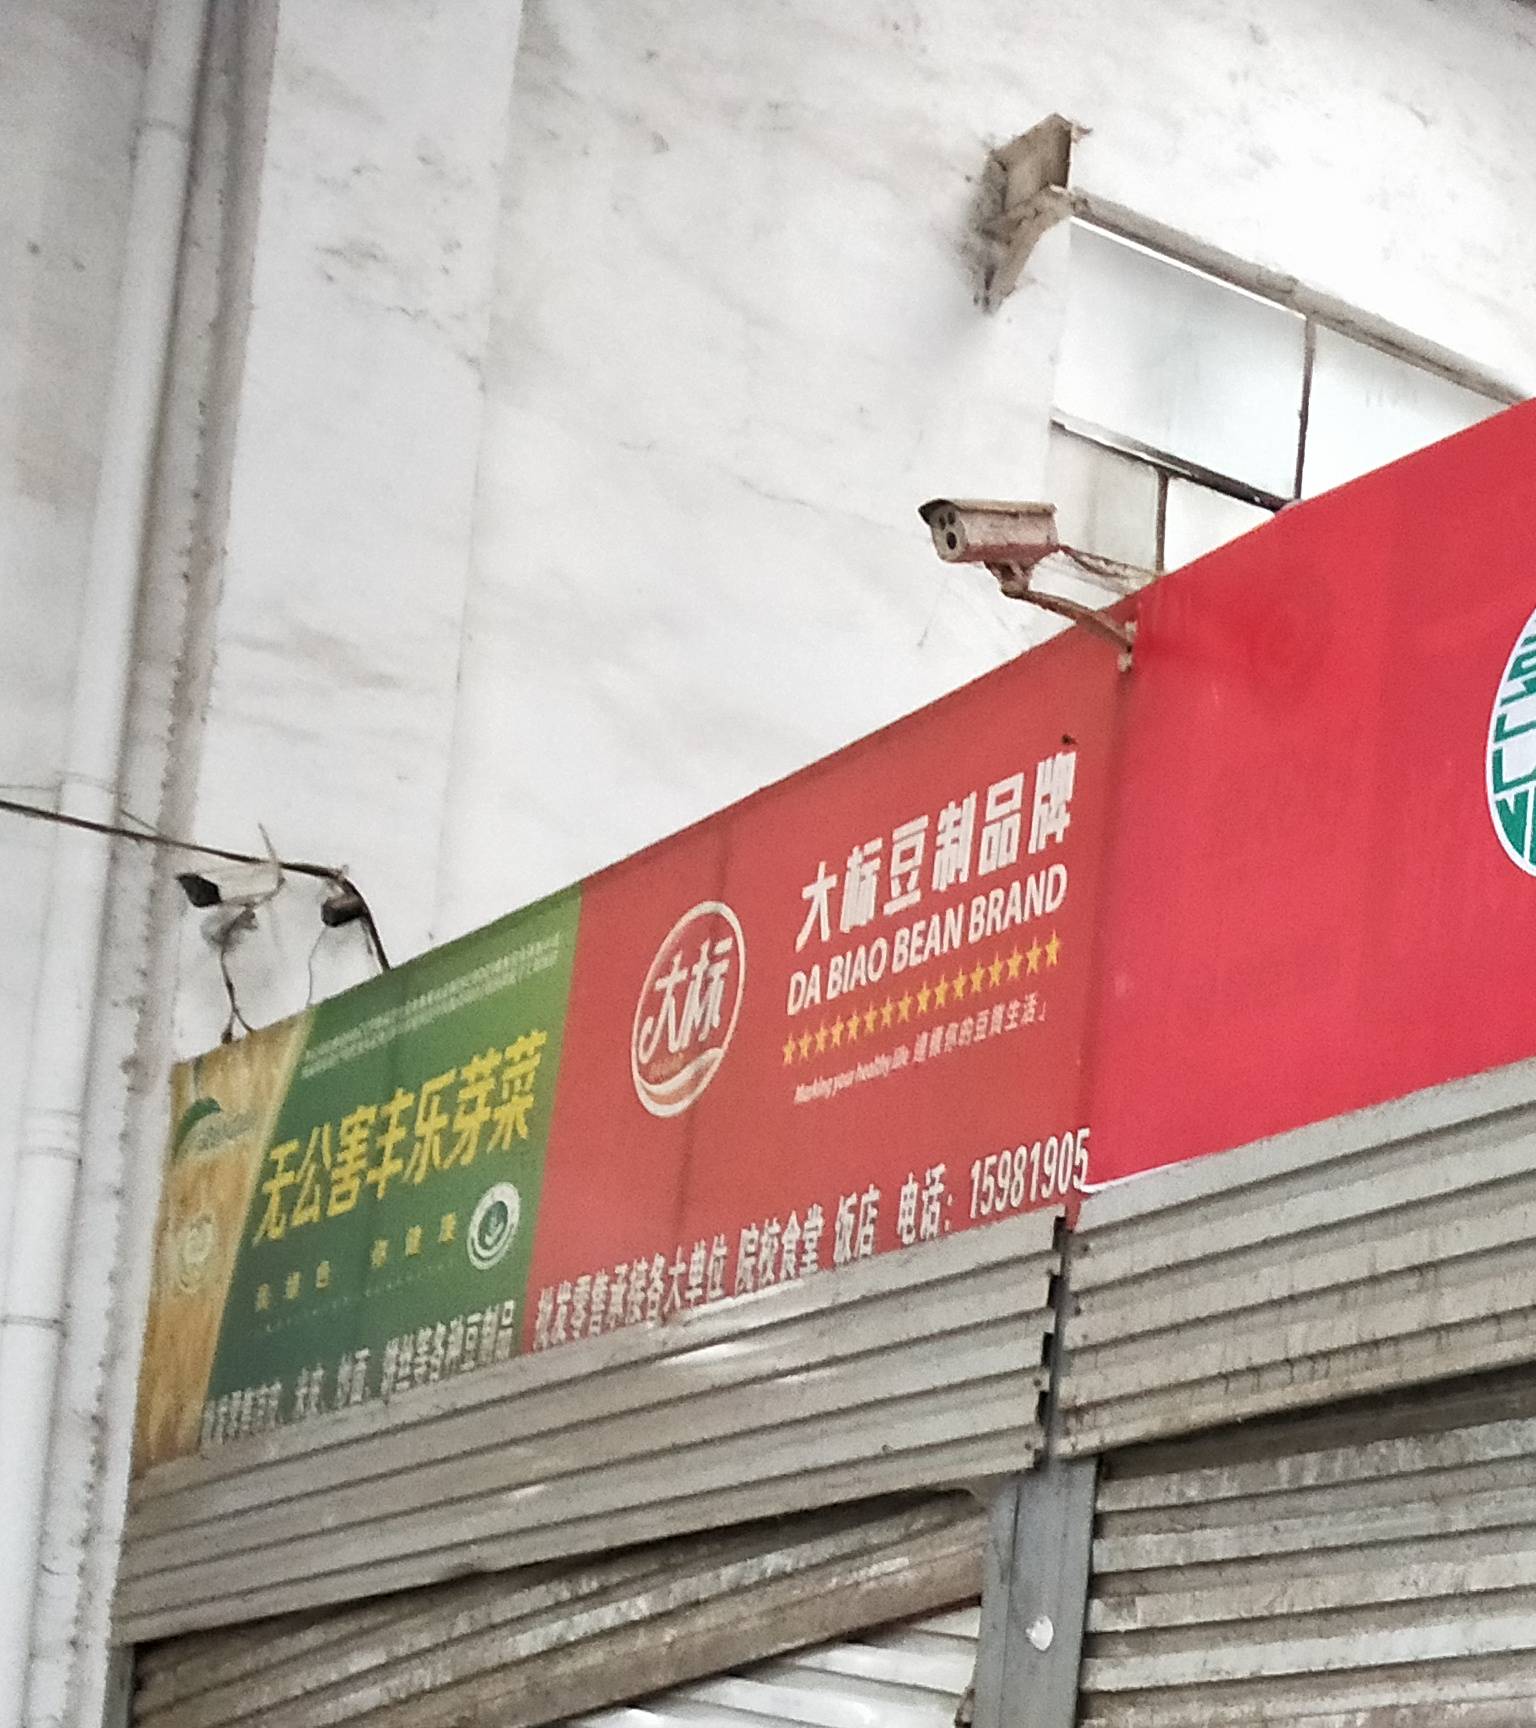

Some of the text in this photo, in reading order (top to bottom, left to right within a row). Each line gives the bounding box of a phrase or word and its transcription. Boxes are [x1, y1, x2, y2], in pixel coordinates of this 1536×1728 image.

[787, 863, 1068, 1016] DA BIAO BEAN BRAND
[795, 751, 1077, 952] 大标豆制品牌
